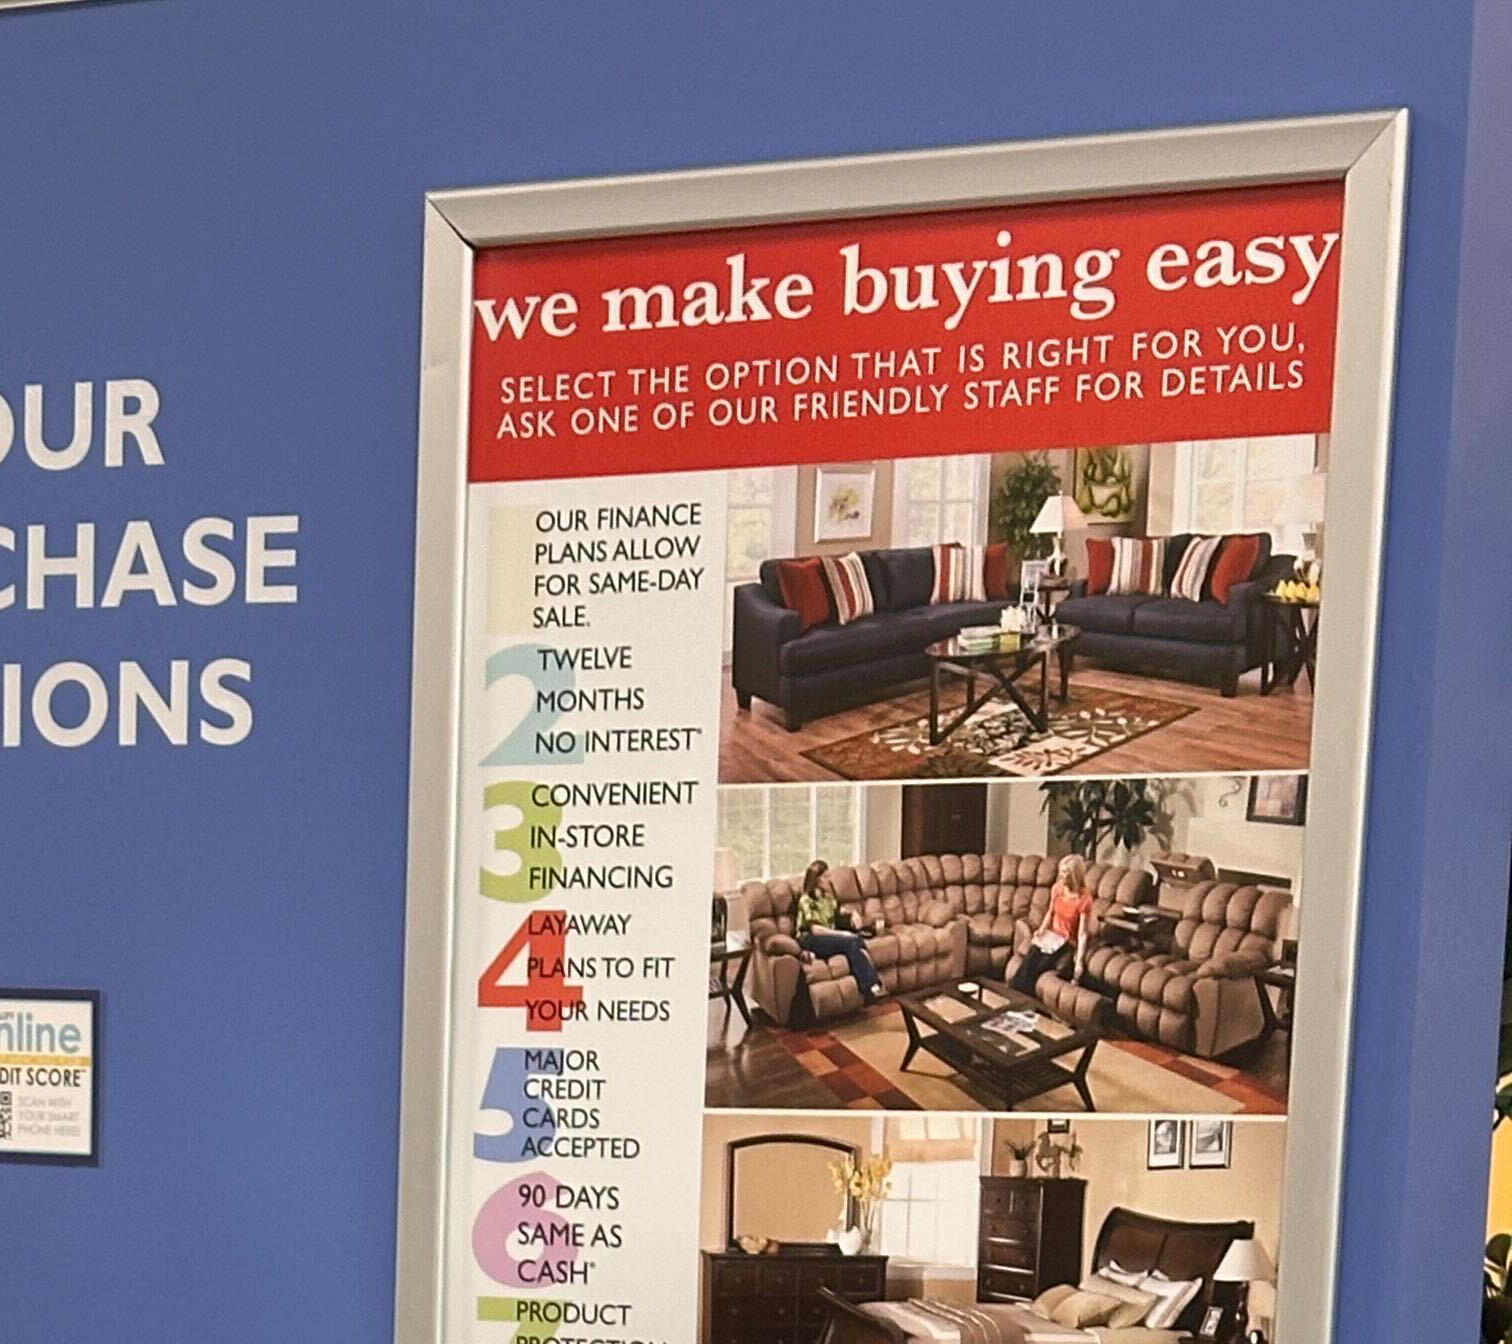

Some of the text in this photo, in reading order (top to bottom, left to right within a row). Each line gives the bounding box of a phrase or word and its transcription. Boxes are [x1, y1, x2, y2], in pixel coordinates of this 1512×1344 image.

[475, 229, 1340, 342] we make buying easy
[500, 321, 1305, 405] SELECT THE OPTION THAT IS RIGHT FOR YOU,
[496, 359, 1305, 440] ASK ONE OF OUR FRIENDLY STAFF FOR DETAILS
[536, 503, 702, 533] OUR FINANCE
[535, 535, 701, 565] PLANS ALLOW
[534, 568, 705, 597] FOR SAME-DAY
[532, 605, 590, 629] SALE.
[537, 646, 633, 672] TWELVE
[478, 643, 585, 768] 2
[536, 687, 645, 713] MONTHS
[535, 730, 575, 754] NO
[531, 780, 699, 808] CONVENIENT
[479, 780, 563, 904] 3
[530, 823, 645, 849] IN-STORE
[529, 864, 674, 890] FINANCING
[527, 912, 632, 936] LAYAWAY
[478, 909, 584, 1032] 4
[526, 957, 675, 979] PLANS TO FIT
[525, 1000, 670, 1022] YOUR NEEDS
[524, 1049, 600, 1076] MAJOR
[523, 1078, 606, 1100] CREDIT
[473, 1047, 564, 1164] 5
[522, 1107, 600, 1130] CARDS
[520, 1136, 640, 1159] ACCEPTED
[518, 1184, 620, 1210] 90 DAYS
[471, 1169, 579, 1290] 6
[517, 1221, 623, 1249] SAME AS
[515, 1301, 632, 1327] PRODUCT
